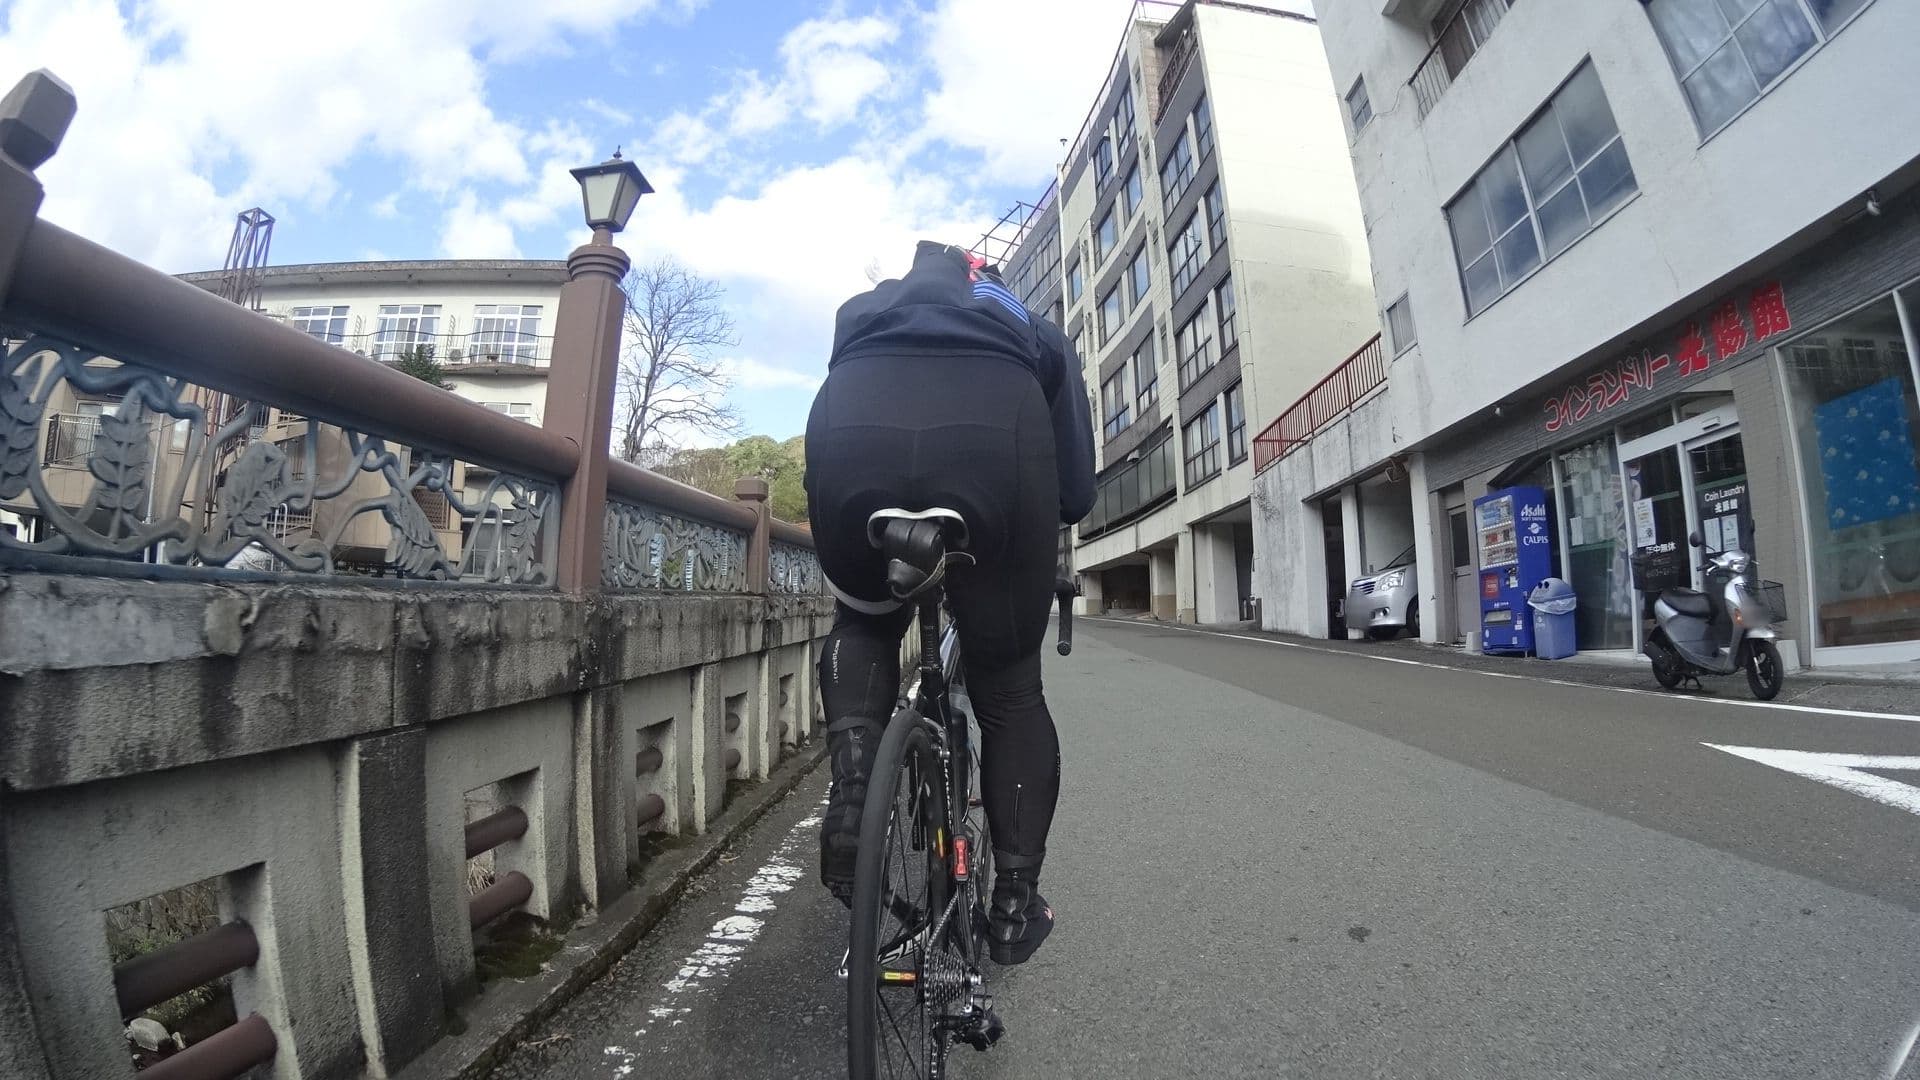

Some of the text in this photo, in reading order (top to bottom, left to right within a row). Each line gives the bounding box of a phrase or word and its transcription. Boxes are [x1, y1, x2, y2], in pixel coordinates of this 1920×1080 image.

[1544, 349, 1671, 432] コインランドリー
[1704, 485, 1745, 502] Coin Laundry
[1521, 504, 1545, 516] Asahi
[1523, 536, 1548, 545] CALPIS
